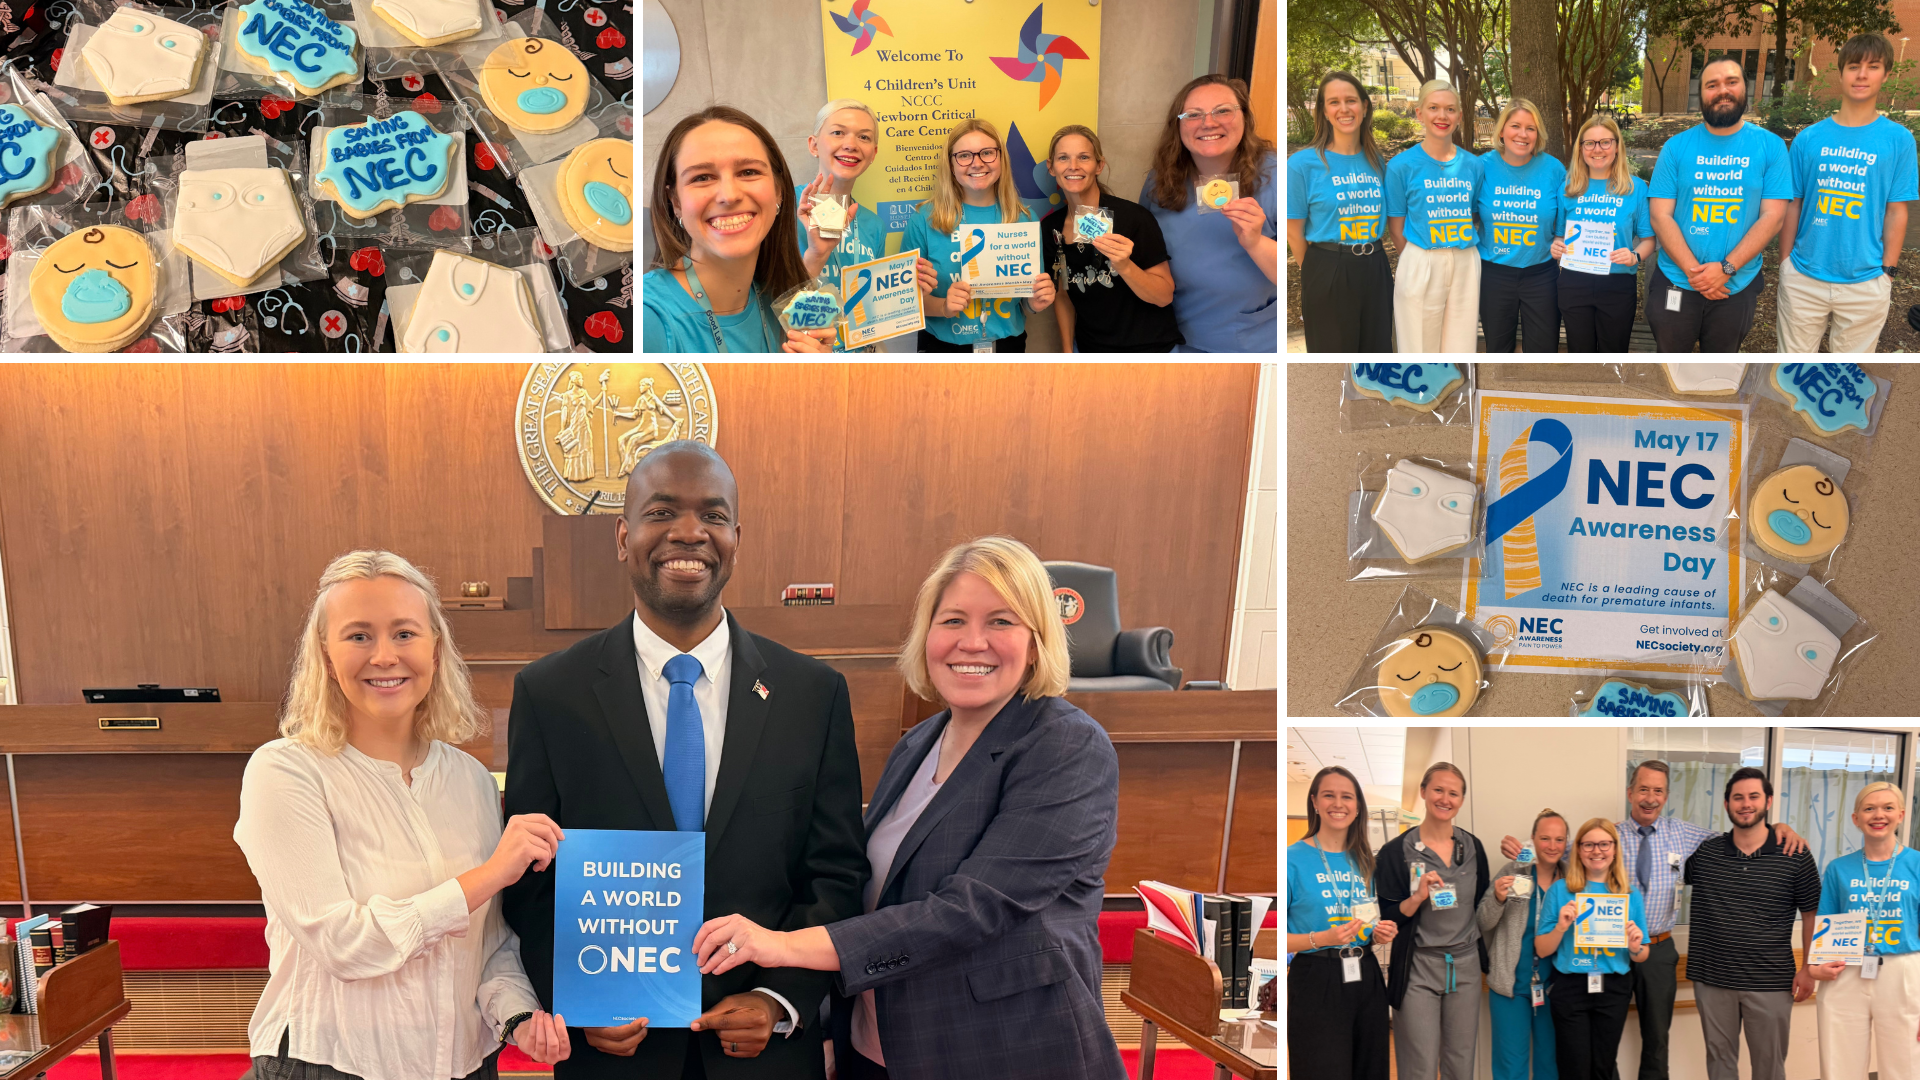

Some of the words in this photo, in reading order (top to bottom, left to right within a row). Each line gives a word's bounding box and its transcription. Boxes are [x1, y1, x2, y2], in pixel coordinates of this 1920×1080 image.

[290, 0, 342, 35] SAVING
[243, 13, 327, 73] NEC
[310, 27, 350, 55] FROM
[876, 50, 941, 62] Welcome
[945, 49, 963, 61] To
[864, 80, 872, 91] 4
[948, 78, 976, 89] Unit
[901, 95, 943, 107] NCCC
[932, 109, 976, 120] Critical
[343, 116, 409, 143] SAVING
[886, 127, 915, 137] Care
[918, 126, 953, 136] Cente
[331, 138, 396, 162] BABIES
[395, 125, 437, 149] FROM
[895, 144, 943, 152] Bienvenidos
[1697, 155, 1750, 168] Building
[1821, 146, 1877, 165] Building
[343, 147, 437, 199] NEC
[1695, 171, 1703, 180] a
[1706, 169, 1743, 180] world
[1819, 163, 1827, 171] a
[1829, 163, 1867, 176] world
[1332, 172, 1381, 187] Building
[1424, 177, 1472, 191] Building
[1817, 176, 1865, 192] without
[1336, 192, 1346, 201] a
[1347, 188, 1381, 199] world
[1495, 185, 1541, 199] Building
[1693, 184, 1743, 196] without
[1426, 195, 1434, 203] a
[1436, 192, 1469, 203] world
[1503, 200, 1536, 209] world
[1577, 194, 1624, 207] Building
[898, 204, 916, 214] UN
[1427, 207, 1471, 218] without
[1584, 207, 1617, 216] world
[1692, 204, 1740, 223] NEC
[1816, 195, 1863, 219] NEC
[1492, 211, 1538, 223] without
[997, 231, 1028, 239] Nurses
[1079, 222, 1100, 238] NEC
[1340, 221, 1379, 240] NEC
[1430, 224, 1473, 243] NEC
[1494, 228, 1537, 246] NEC
[1012, 241, 1036, 249] world
[997, 253, 1030, 261] without
[1583, 247, 1608, 258] NEC
[889, 261, 906, 270] May
[996, 263, 1032, 277] NEC
[876, 270, 913, 291] NEC
[872, 287, 914, 302] Awareness
[900, 296, 915, 304] Day
[706, 310, 718, 330] Good
[791, 312, 827, 327] NEC
[714, 331, 723, 345] Lab
[862, 327, 875, 335] NEC
[1355, 363, 1428, 393] NEC
[1783, 363, 1843, 417] NEC
[1837, 375, 1864, 410] FROM
[524, 395, 542, 460] GREAT
[1634, 430, 1690, 456] May
[1696, 432, 1719, 451] 17
[532, 457, 560, 497] THE
[1587, 459, 1715, 510] NEC
[587, 488, 616, 501] ARIL
[1568, 517, 1716, 543] Awareness
[1663, 552, 1717, 580] Day
[1561, 582, 1585, 592] NEC
[1588, 583, 1598, 592] is
[1602, 585, 1610, 593] a
[1614, 585, 1660, 597] leading
[1664, 588, 1700, 597] cause
[1704, 589, 1717, 598] of
[1541, 593, 1577, 604] death
[1581, 595, 1598, 604] for
[1601, 595, 1666, 608] premature
[1670, 599, 1715, 610] infants.
[1519, 617, 1564, 635] NEC
[1640, 624, 1659, 635] Get
[1662, 625, 1709, 637] involved
[1711, 628, 1724, 638] at
[1636, 640, 1724, 657] NECsociety.org
[1618, 688, 1676, 717] SAVING
[583, 862, 682, 879] BUILDING
[580, 890, 597, 905] A
[603, 890, 682, 907] WORLD
[1322, 889, 1332, 898] a
[1849, 894, 1858, 902] a
[1325, 903, 1352, 914] with
[1436, 898, 1452, 906] NEC
[1597, 906, 1623, 916] NEC
[578, 918, 679, 935] WITHOUT
[1832, 938, 1858, 947] NEC
[1868, 926, 1902, 945] EC
